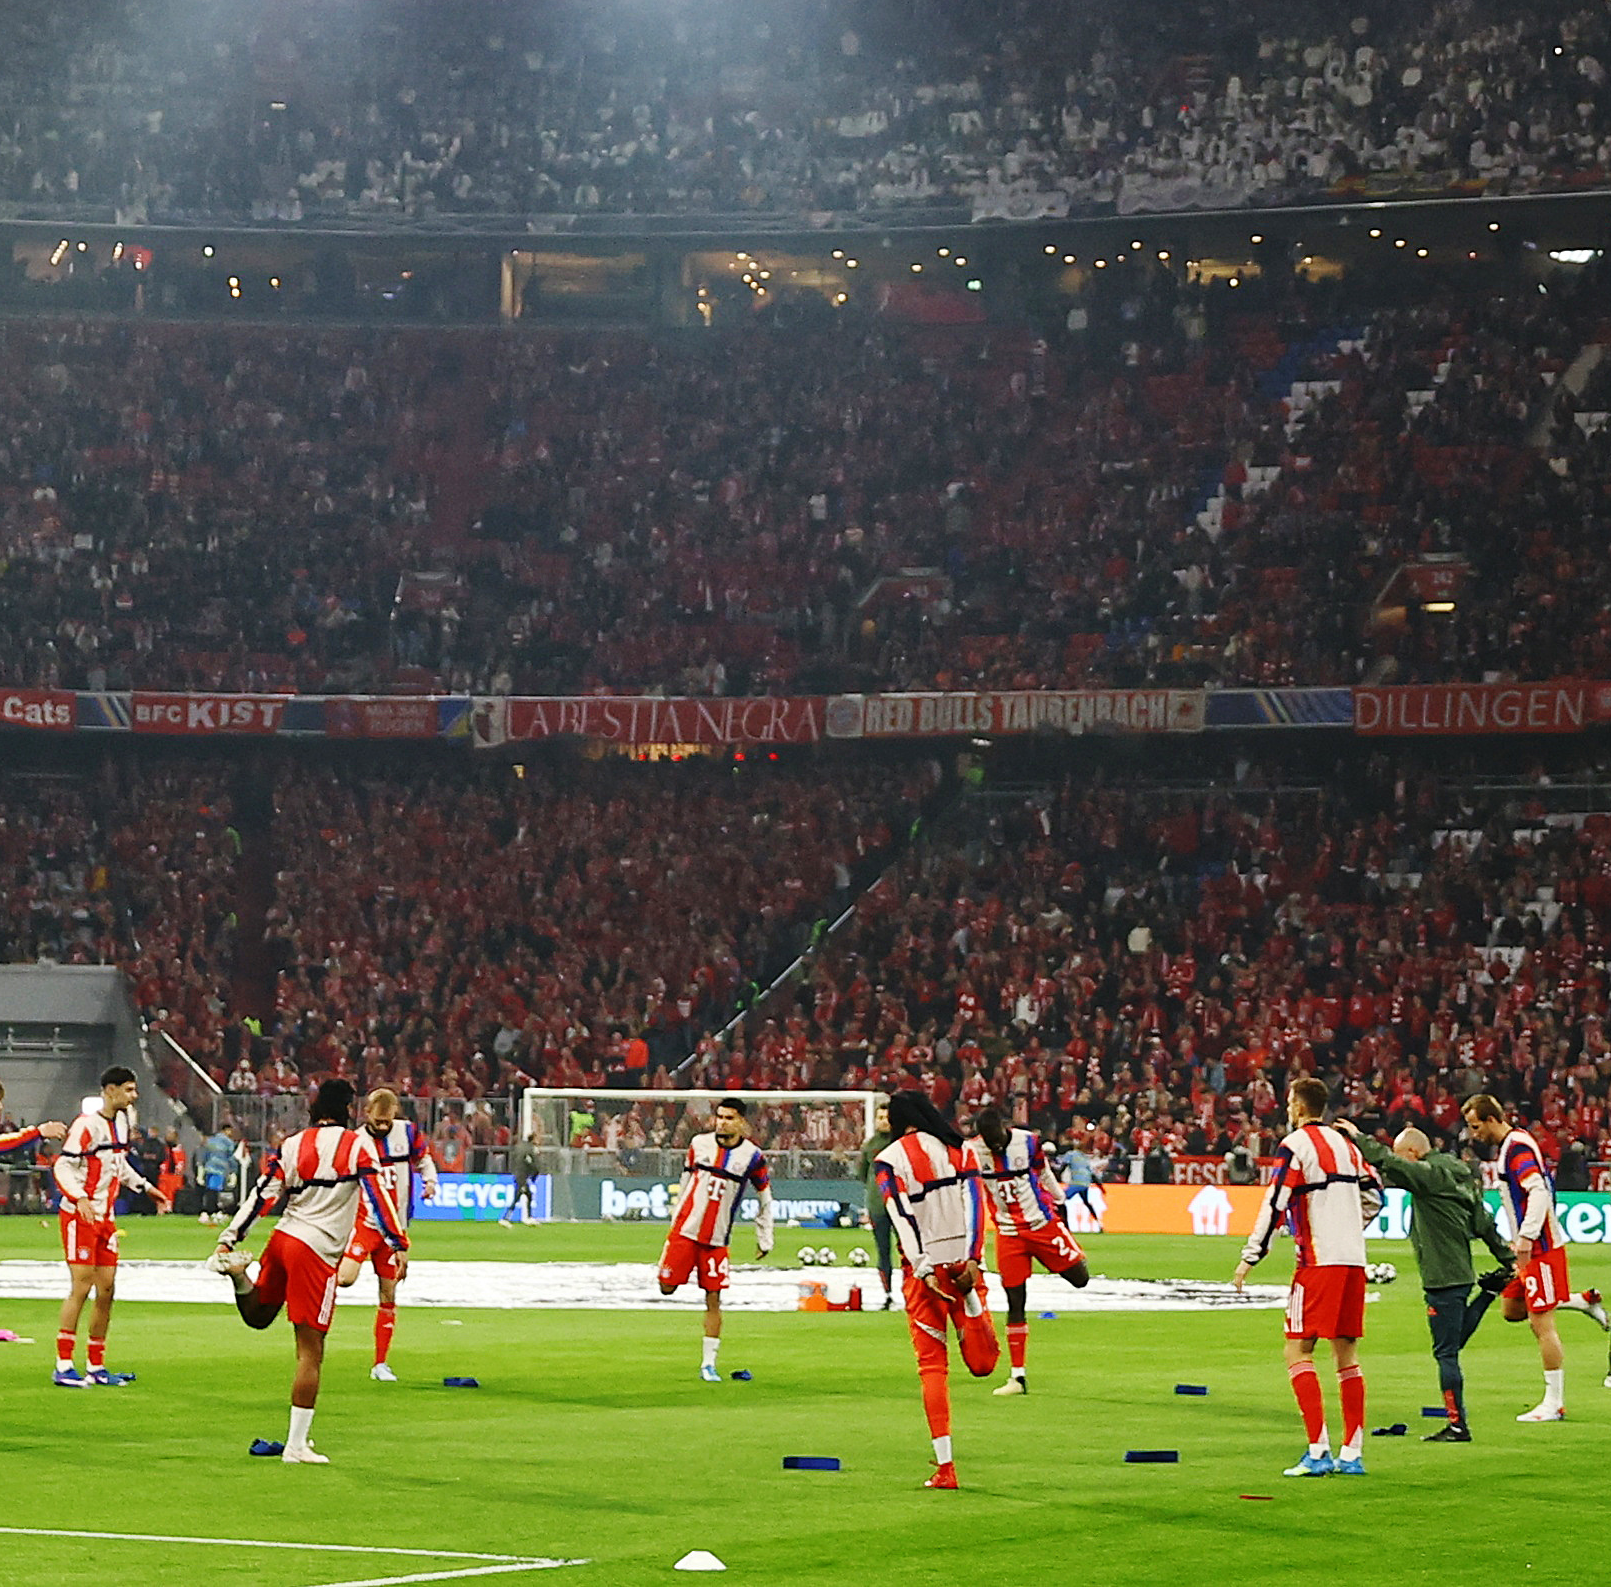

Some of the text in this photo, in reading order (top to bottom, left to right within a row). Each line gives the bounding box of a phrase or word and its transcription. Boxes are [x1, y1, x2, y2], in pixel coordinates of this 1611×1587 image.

[3, 696, 71, 725] Cats
[135, 700, 284, 728] BFC KIST
[695, 699, 819, 743] NEGRA
[1354, 689, 1584, 730] DILLINGEN
[1524, 1275, 1538, 1298] 9
